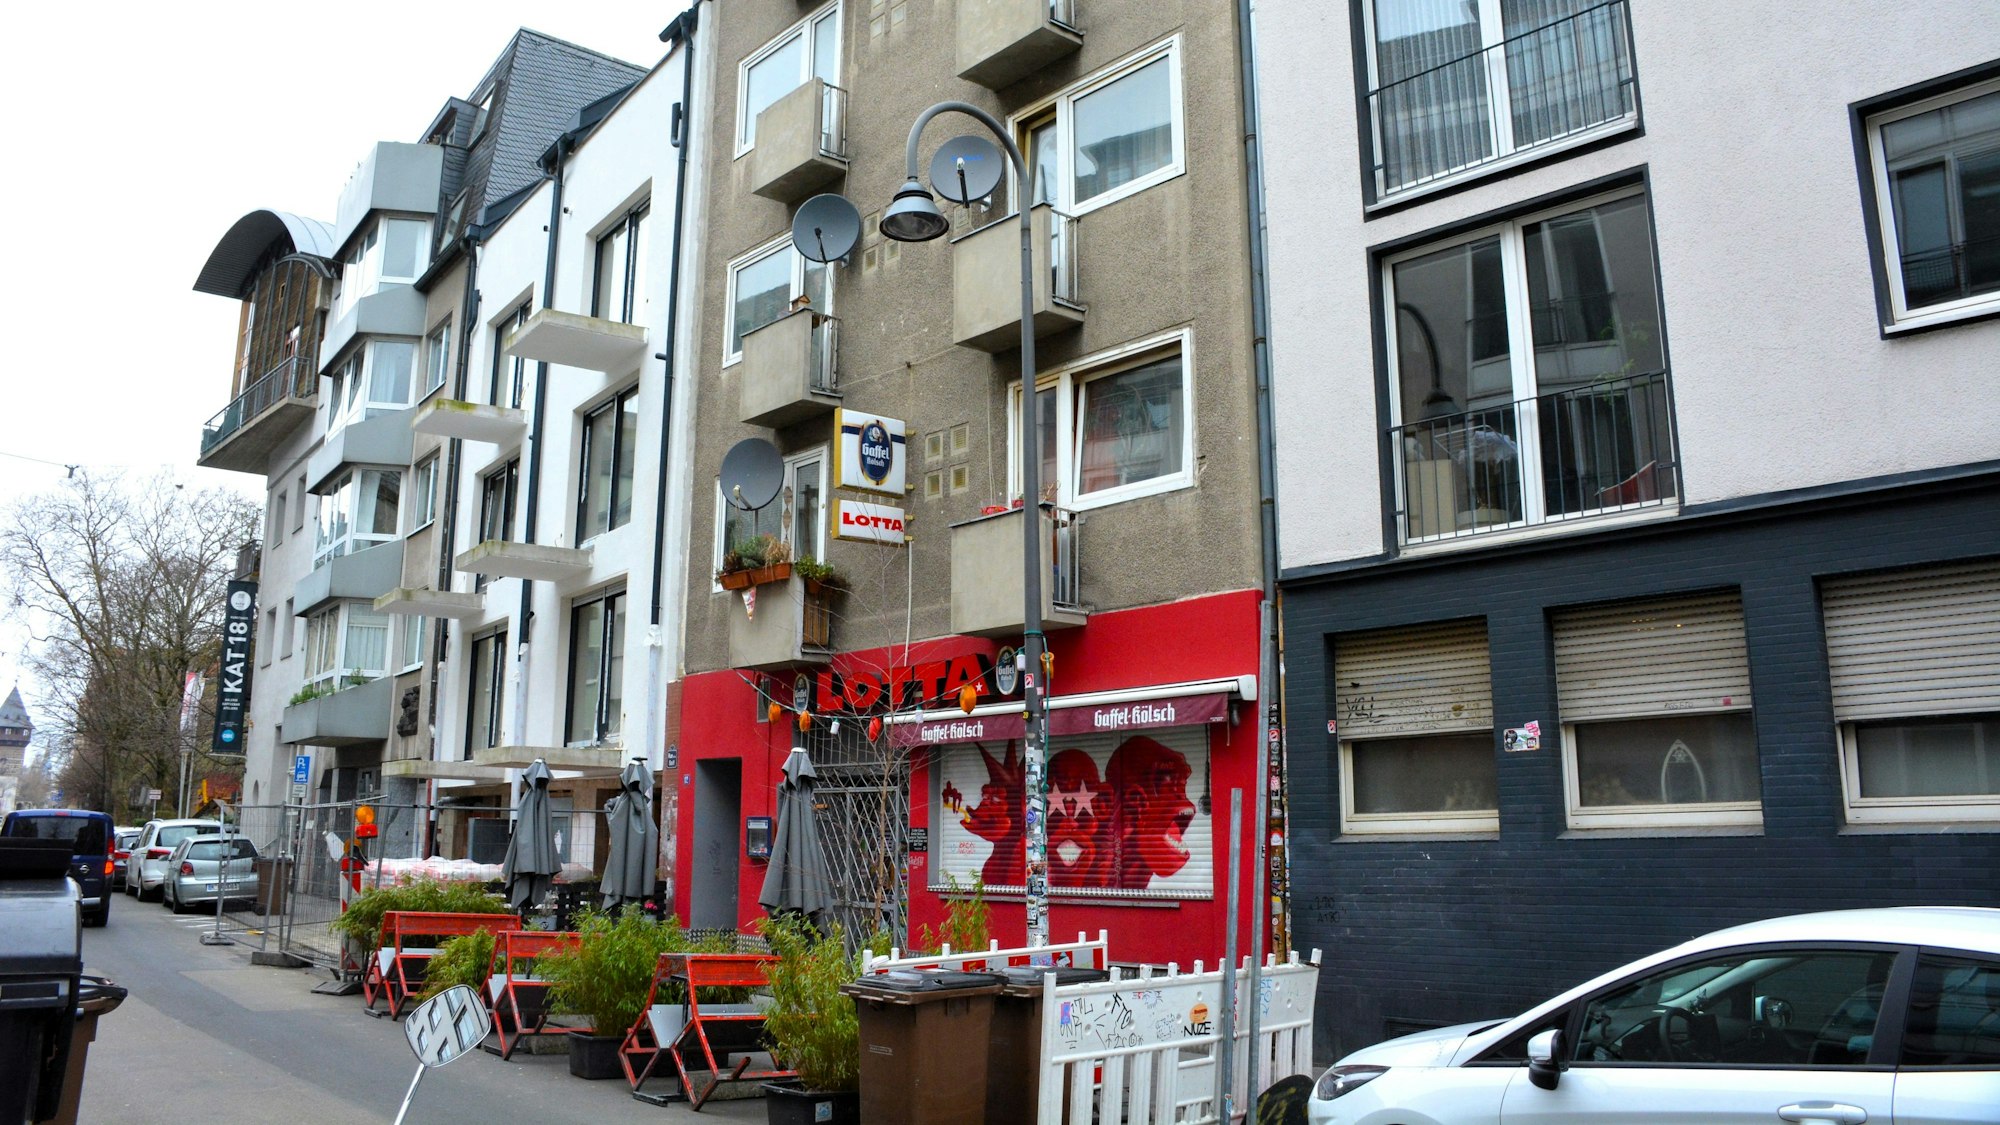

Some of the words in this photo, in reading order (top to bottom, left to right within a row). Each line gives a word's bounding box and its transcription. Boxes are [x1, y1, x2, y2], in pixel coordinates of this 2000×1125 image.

[862, 443, 890, 460] Gaffel
[843, 512, 904, 532] LOTTA
[817, 653, 990, 711] LOTTA
[1094, 702, 1176, 729] Gaffel-Kölsch
